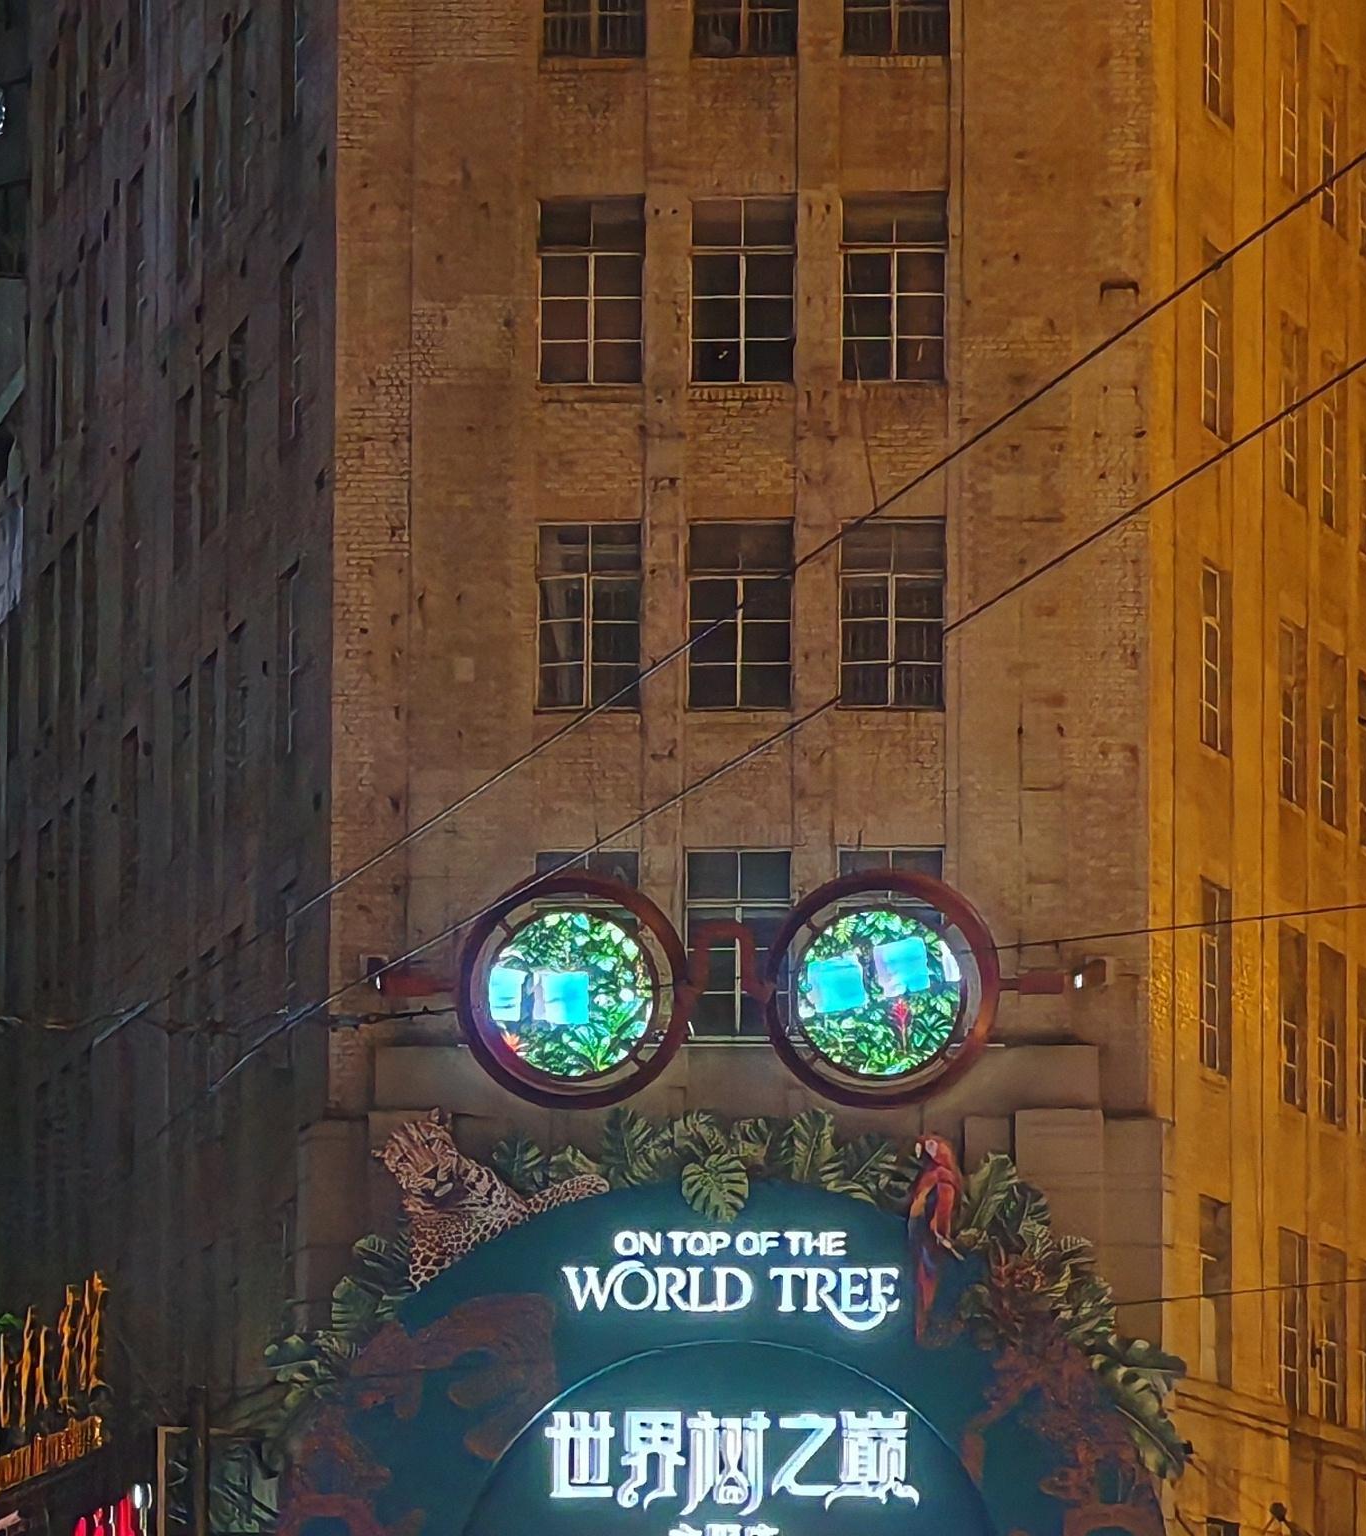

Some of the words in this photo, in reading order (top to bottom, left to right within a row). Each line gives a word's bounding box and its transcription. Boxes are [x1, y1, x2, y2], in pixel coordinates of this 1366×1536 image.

[613, 1231, 662, 1257] ON
[667, 1231, 731, 1257] TOP
[735, 1231, 780, 1257] OF
[784, 1231, 847, 1257] THE
[560, 1260, 754, 1312] WORLD
[768, 1266, 901, 1331] TREE
[544, 1410, 920, 1516] 世界树之巅
